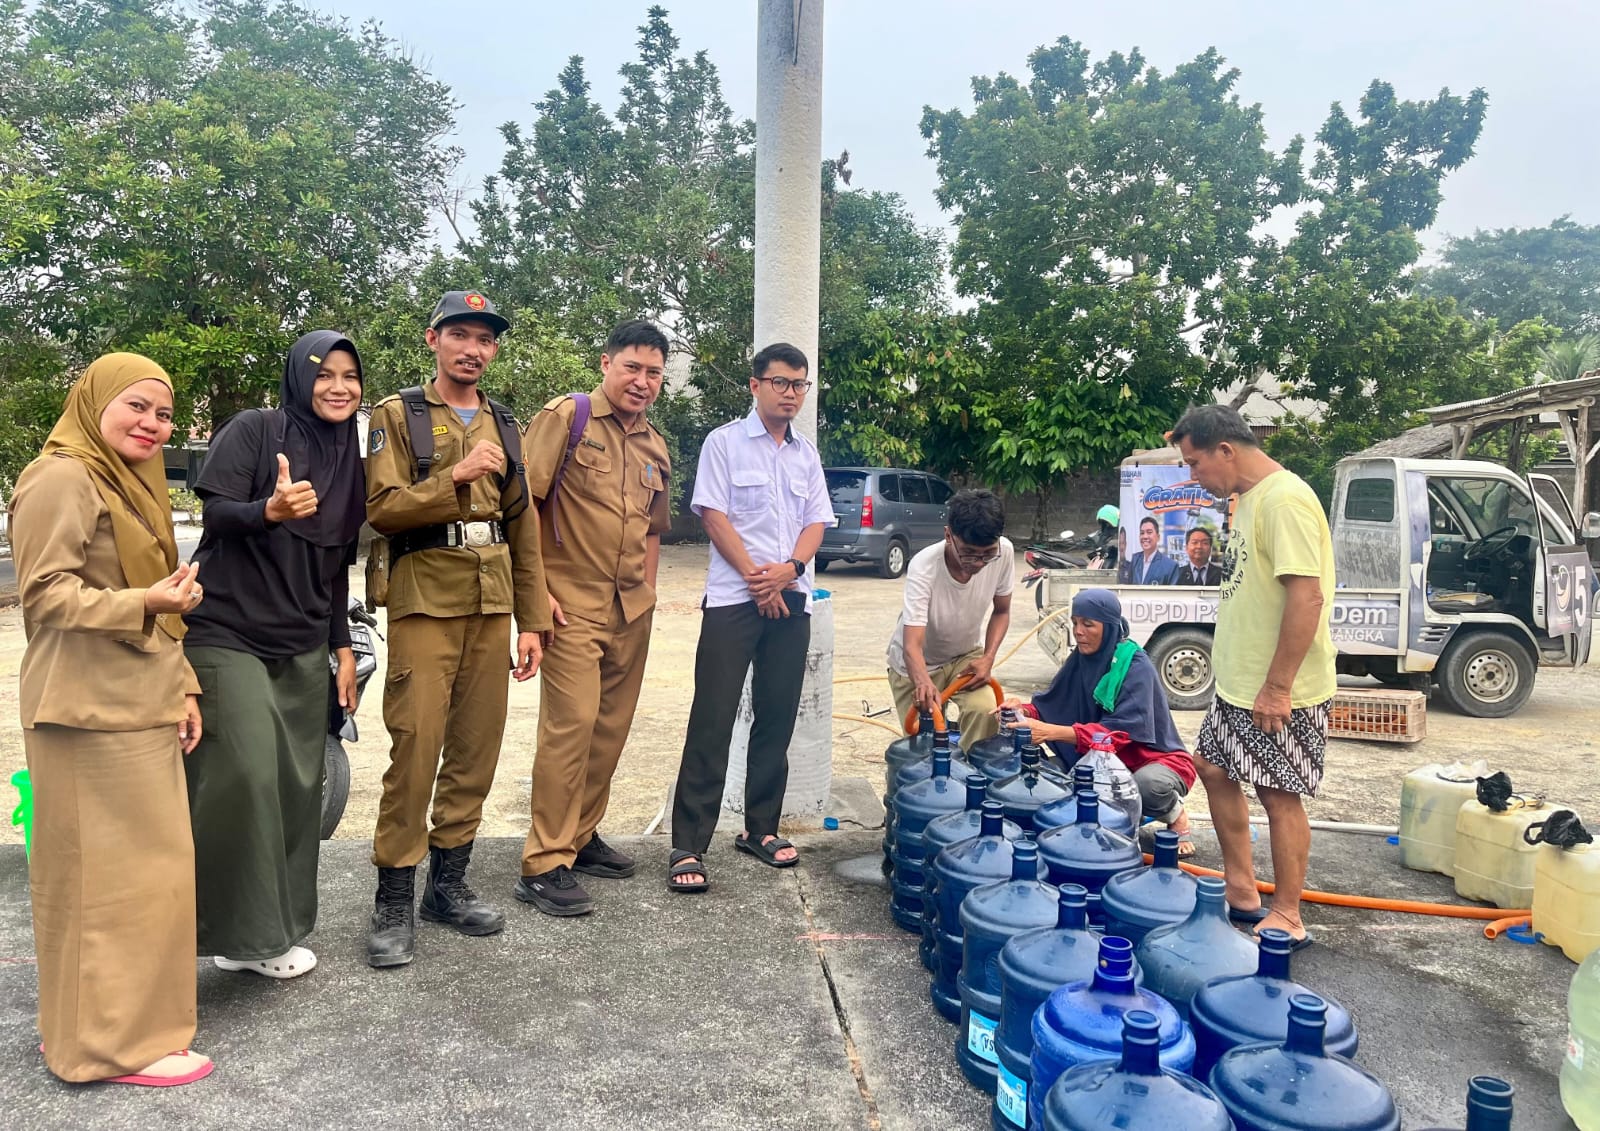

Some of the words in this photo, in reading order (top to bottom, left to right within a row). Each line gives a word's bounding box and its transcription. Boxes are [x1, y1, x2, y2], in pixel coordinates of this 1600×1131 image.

[1143, 485, 1214, 510] GRATIS
[1574, 565, 1587, 627] 5
[1131, 600, 1188, 623] DPD
